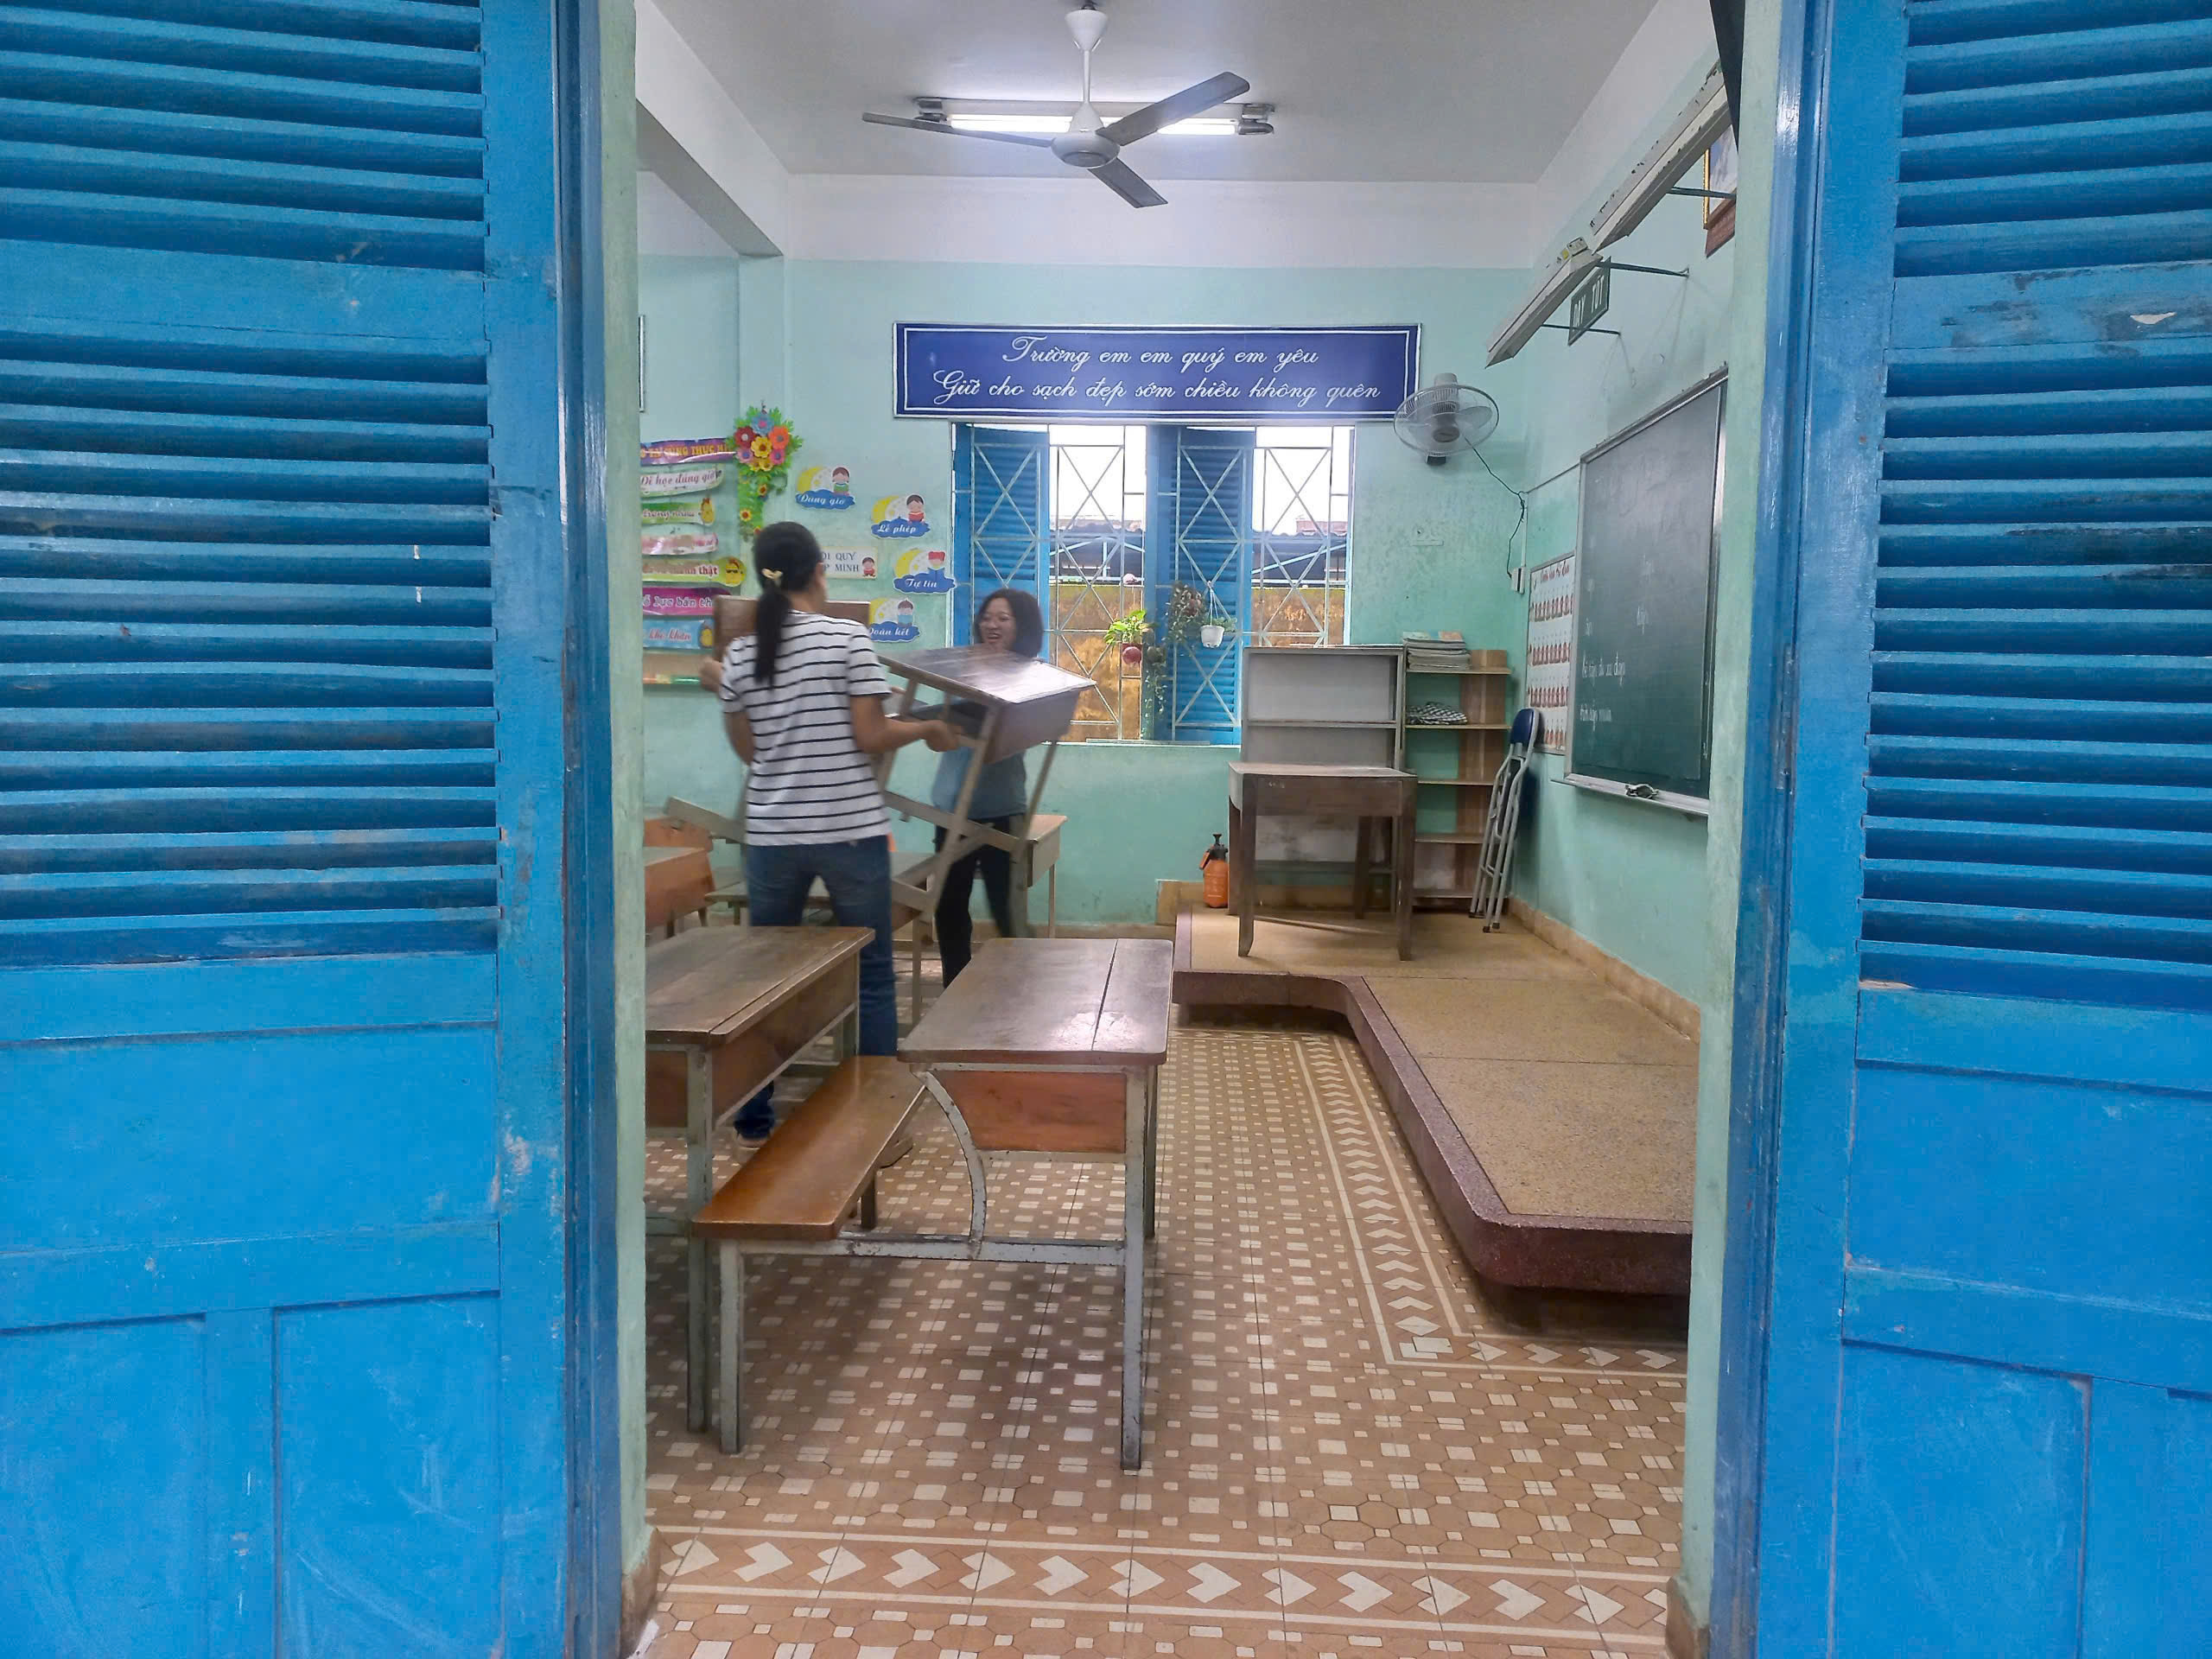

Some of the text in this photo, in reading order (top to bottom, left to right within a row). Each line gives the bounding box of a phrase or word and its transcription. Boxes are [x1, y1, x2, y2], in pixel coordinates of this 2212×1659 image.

[1001, 335, 1319, 373] Trường em em quý em yêu
[932, 370, 1382, 409] Giữ cho sạch đẹp sớm chiều không quên
